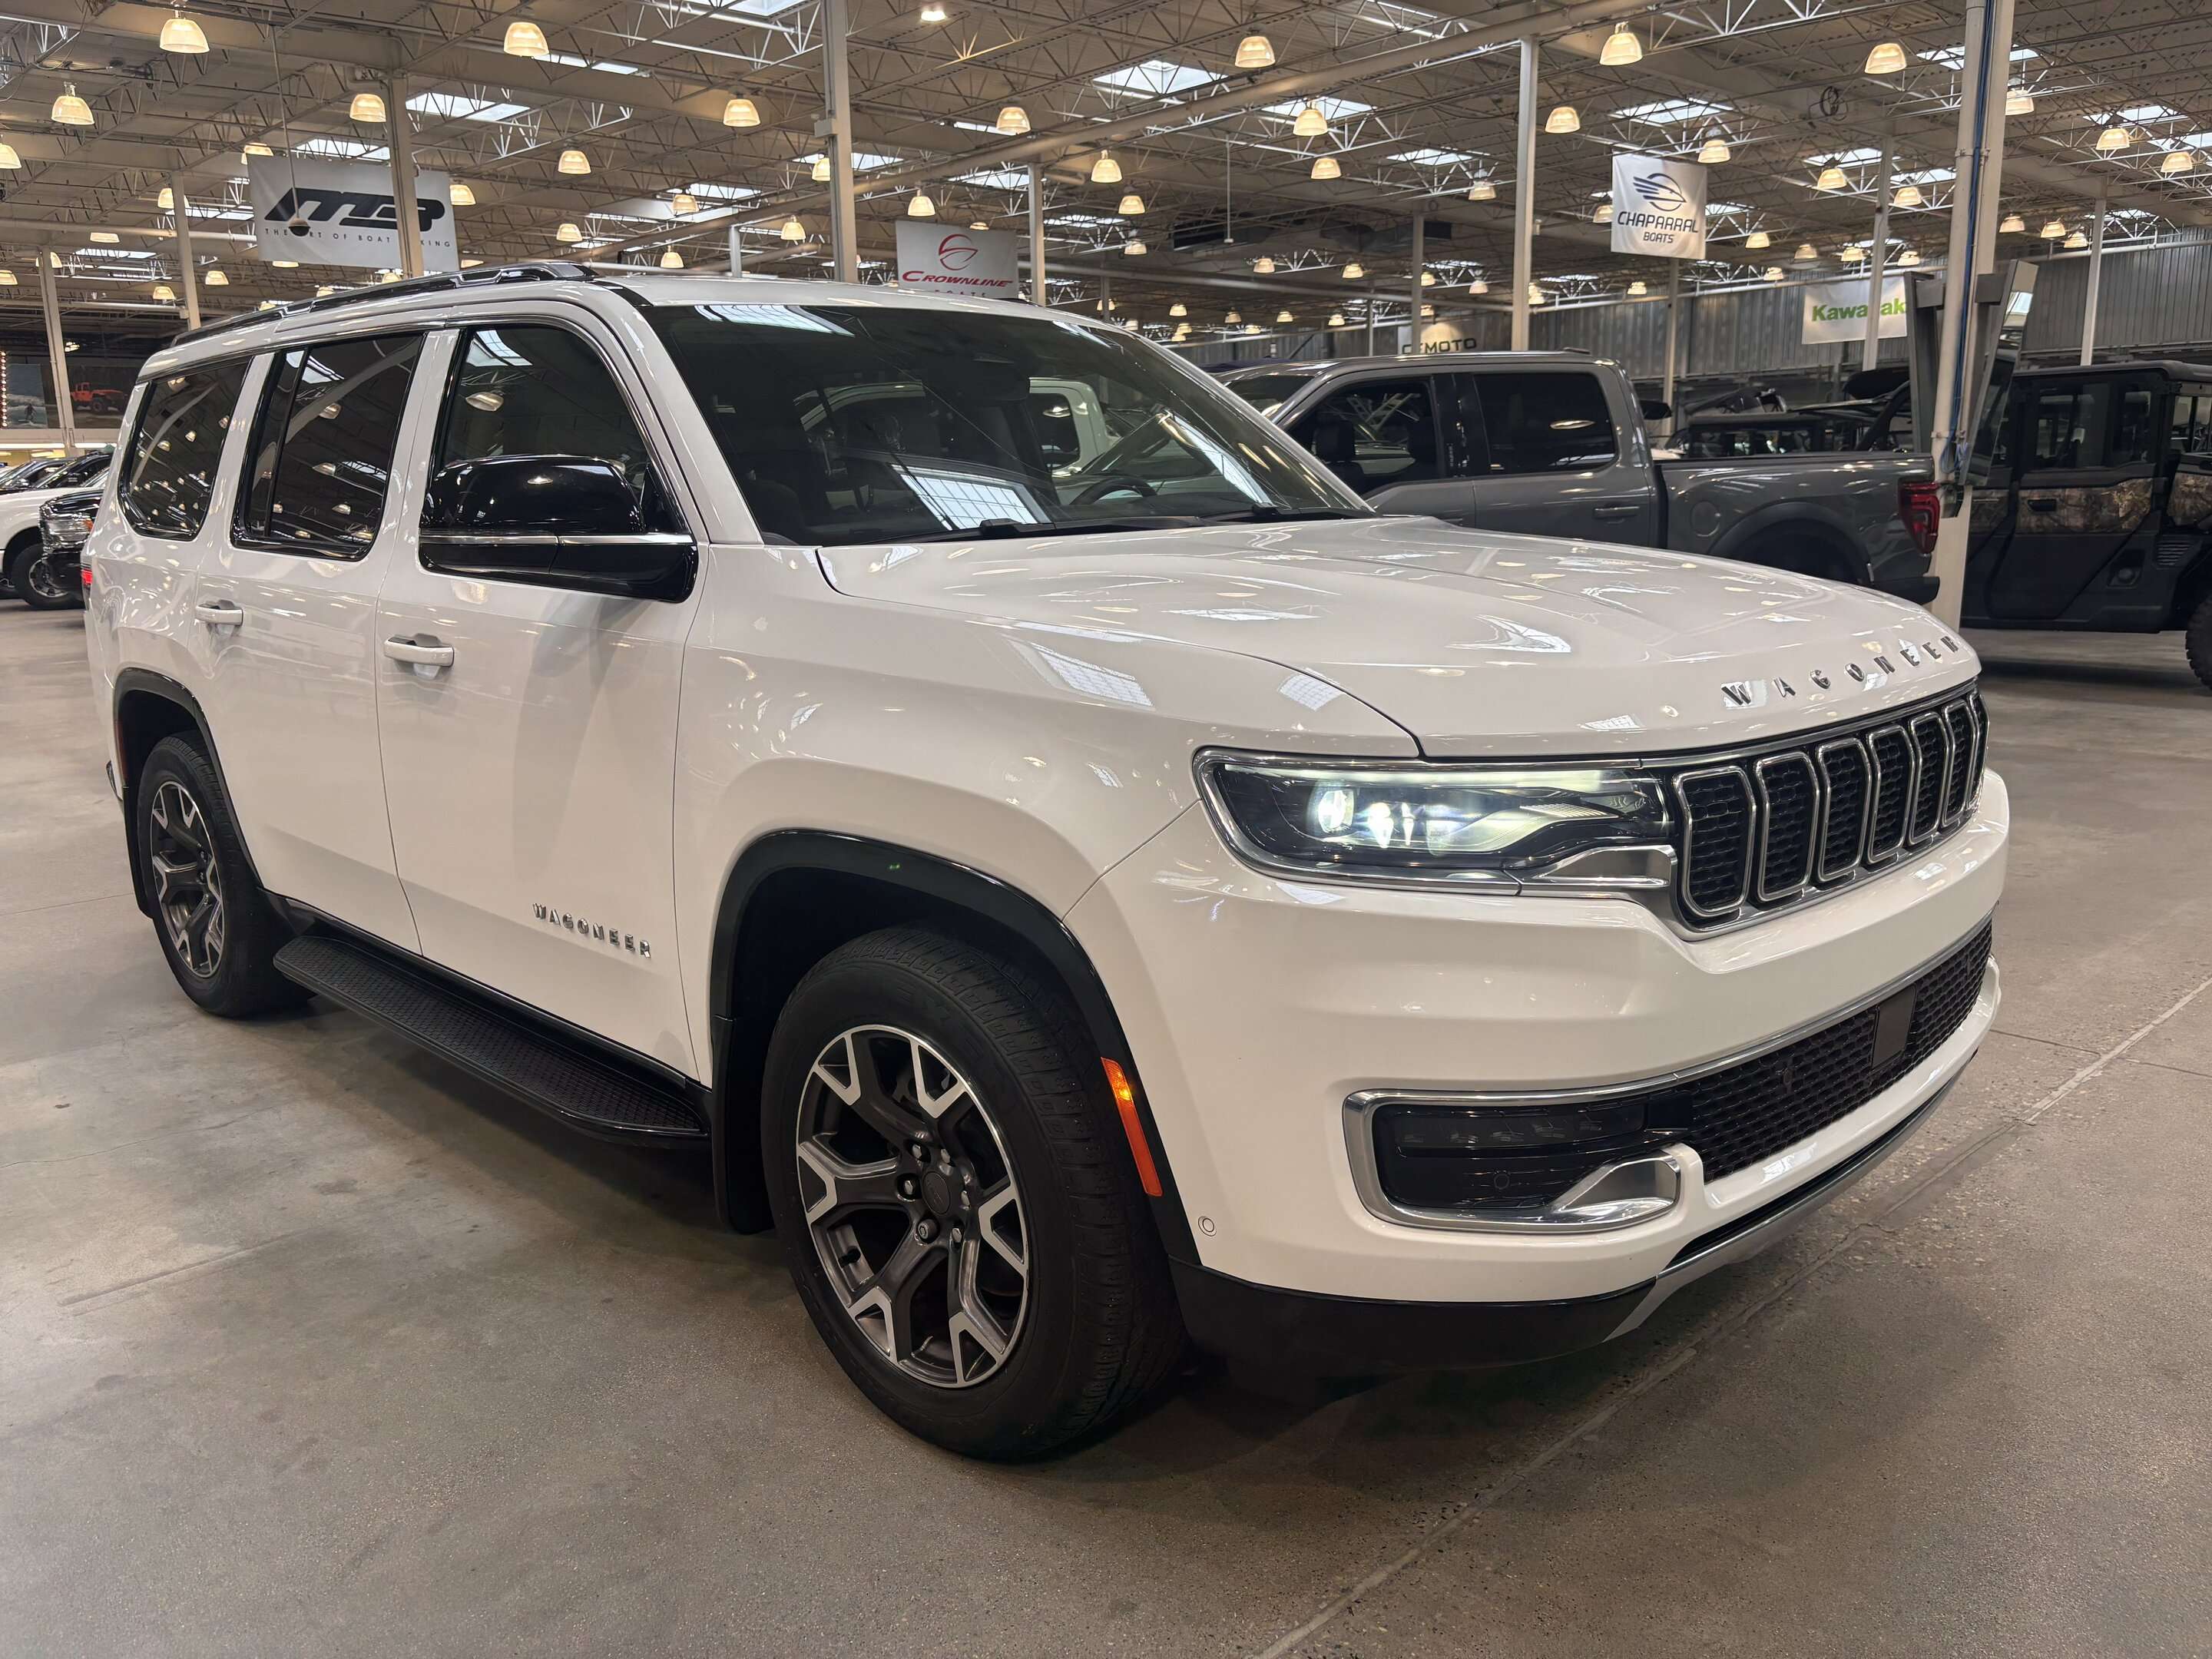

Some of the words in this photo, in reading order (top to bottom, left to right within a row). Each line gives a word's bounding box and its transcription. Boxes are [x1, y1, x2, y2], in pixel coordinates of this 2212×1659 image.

[265, 227, 288, 236] THE
[1618, 211, 1698, 233] CHAPARRAL
[1644, 232, 1674, 243] BOATS
[1812, 297, 1906, 321] Kawaak
[1402, 338, 1476, 354] CMOTO
[1721, 635, 1959, 706] WAGONEER
[532, 902, 651, 959] WAGONEER
